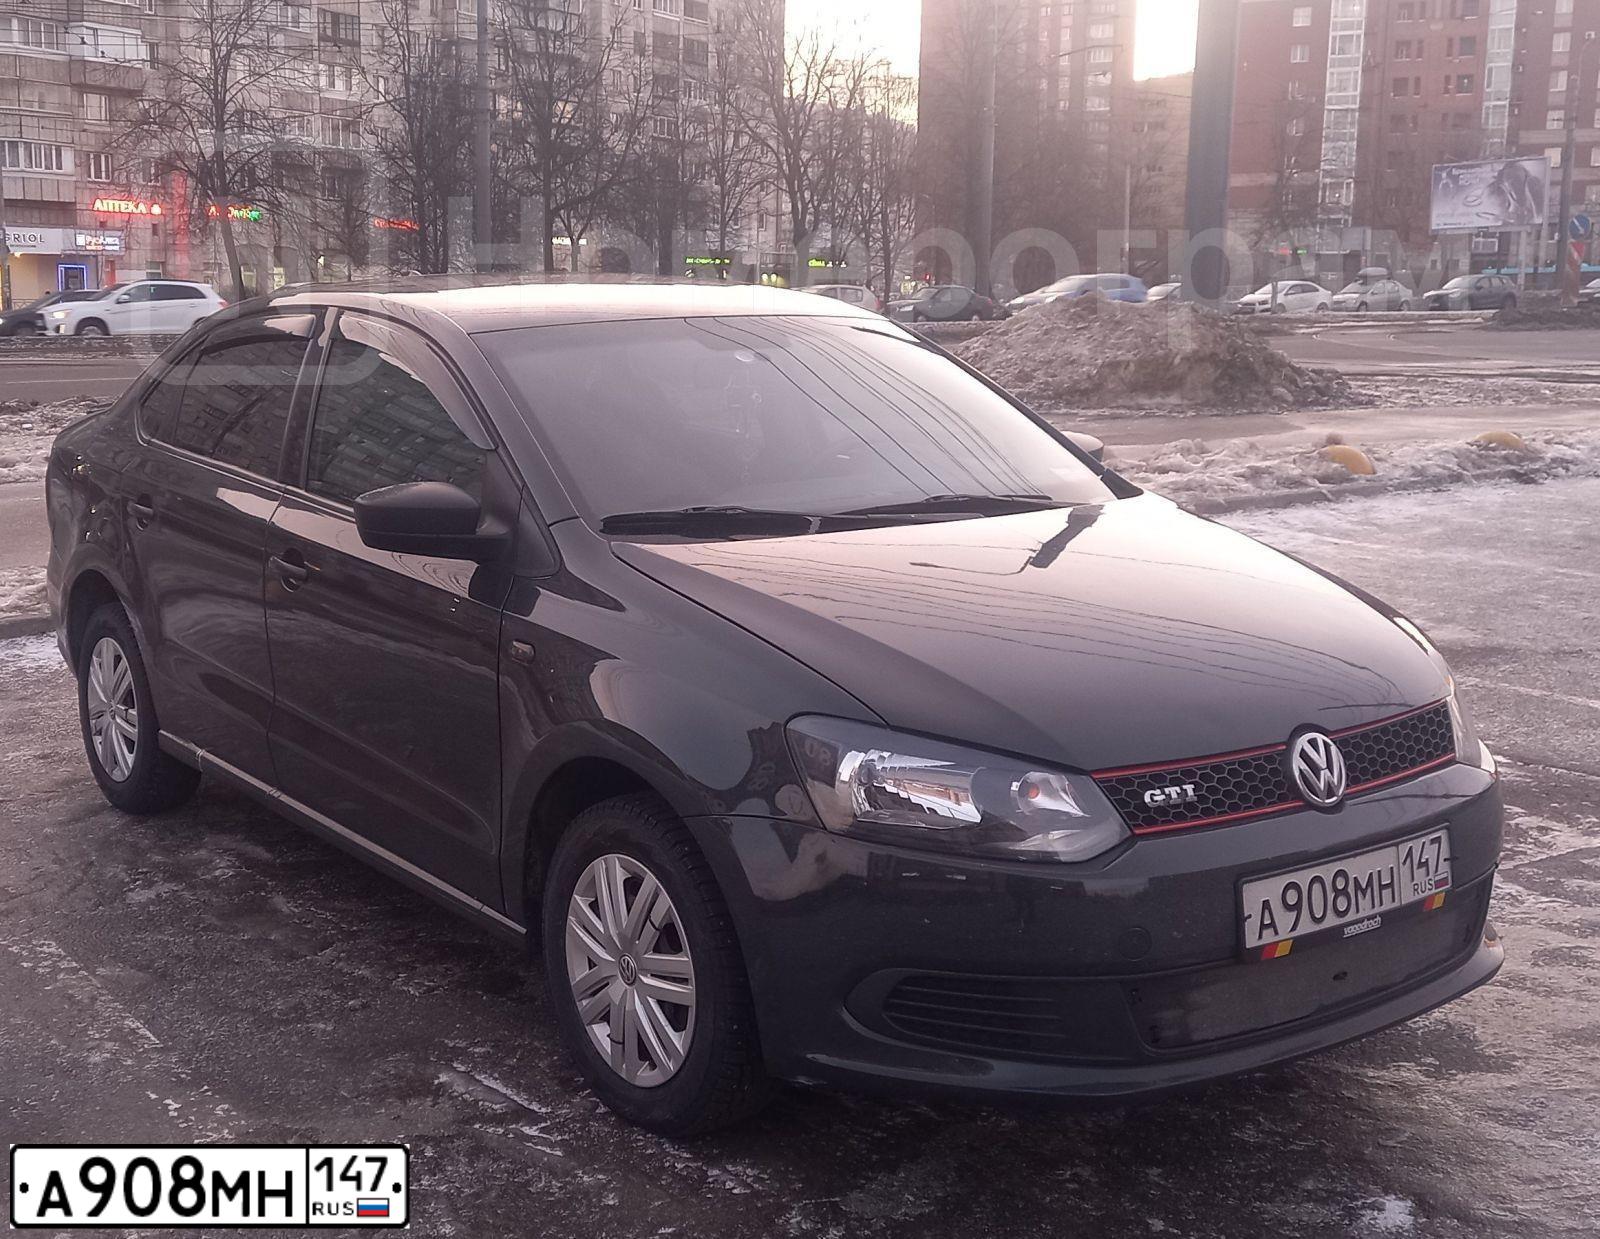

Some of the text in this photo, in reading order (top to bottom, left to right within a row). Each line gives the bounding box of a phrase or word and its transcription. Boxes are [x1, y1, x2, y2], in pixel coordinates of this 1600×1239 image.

[93, 198, 147, 214] АПТЕКА
[1144, 784, 1198, 807] GTI
[1257, 834, 1442, 940] А908МН 147
[1412, 878, 1434, 897] RUS
